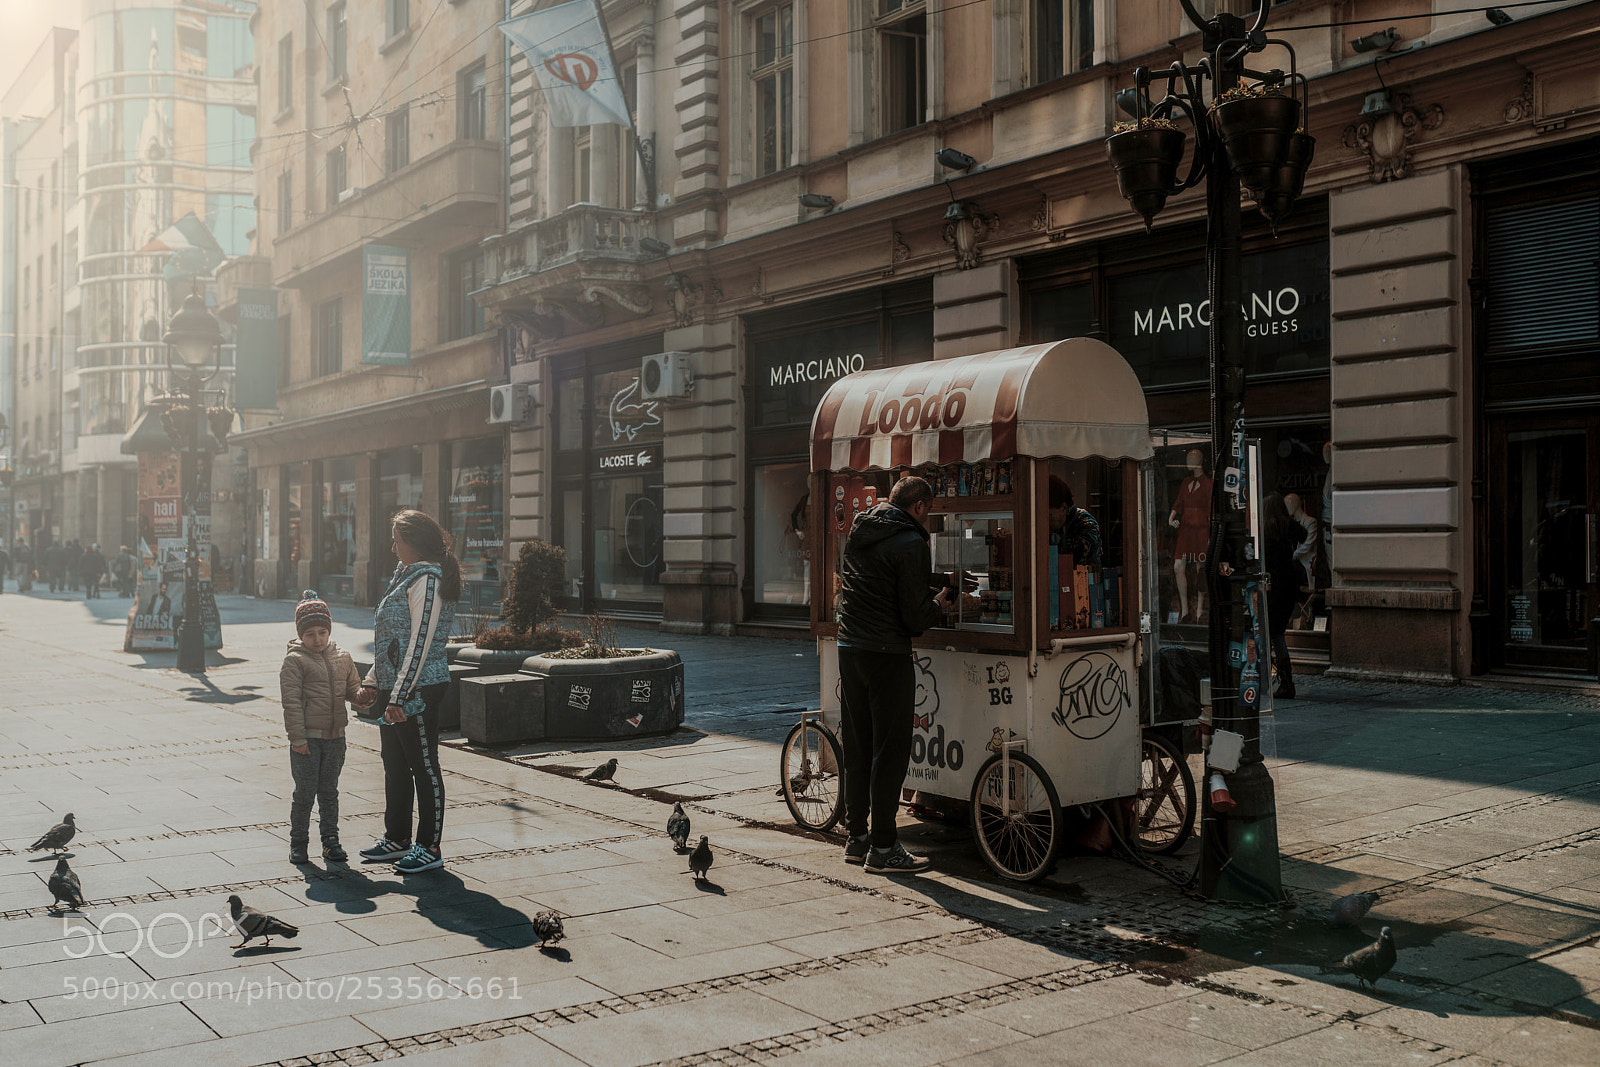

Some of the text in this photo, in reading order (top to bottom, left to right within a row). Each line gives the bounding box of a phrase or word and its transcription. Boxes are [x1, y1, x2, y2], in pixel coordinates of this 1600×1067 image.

[370, 266, 404, 279] ŠKOLA
[369, 279, 405, 290] JEZIKA
[1134, 287, 1300, 336] MARCNO
[1247, 319, 1298, 338] GUESS
[770, 353, 864, 387] MARCIANO
[858, 381, 967, 436] Loodo
[599, 454, 635, 468] LACOSTE
[154, 499, 177, 516] hari
[986, 666, 995, 684] I
[989, 686, 1013, 706] BG
[911, 725, 963, 771] odo
[925, 768, 939, 781] FUN!
[988, 779, 1015, 800] FU!
